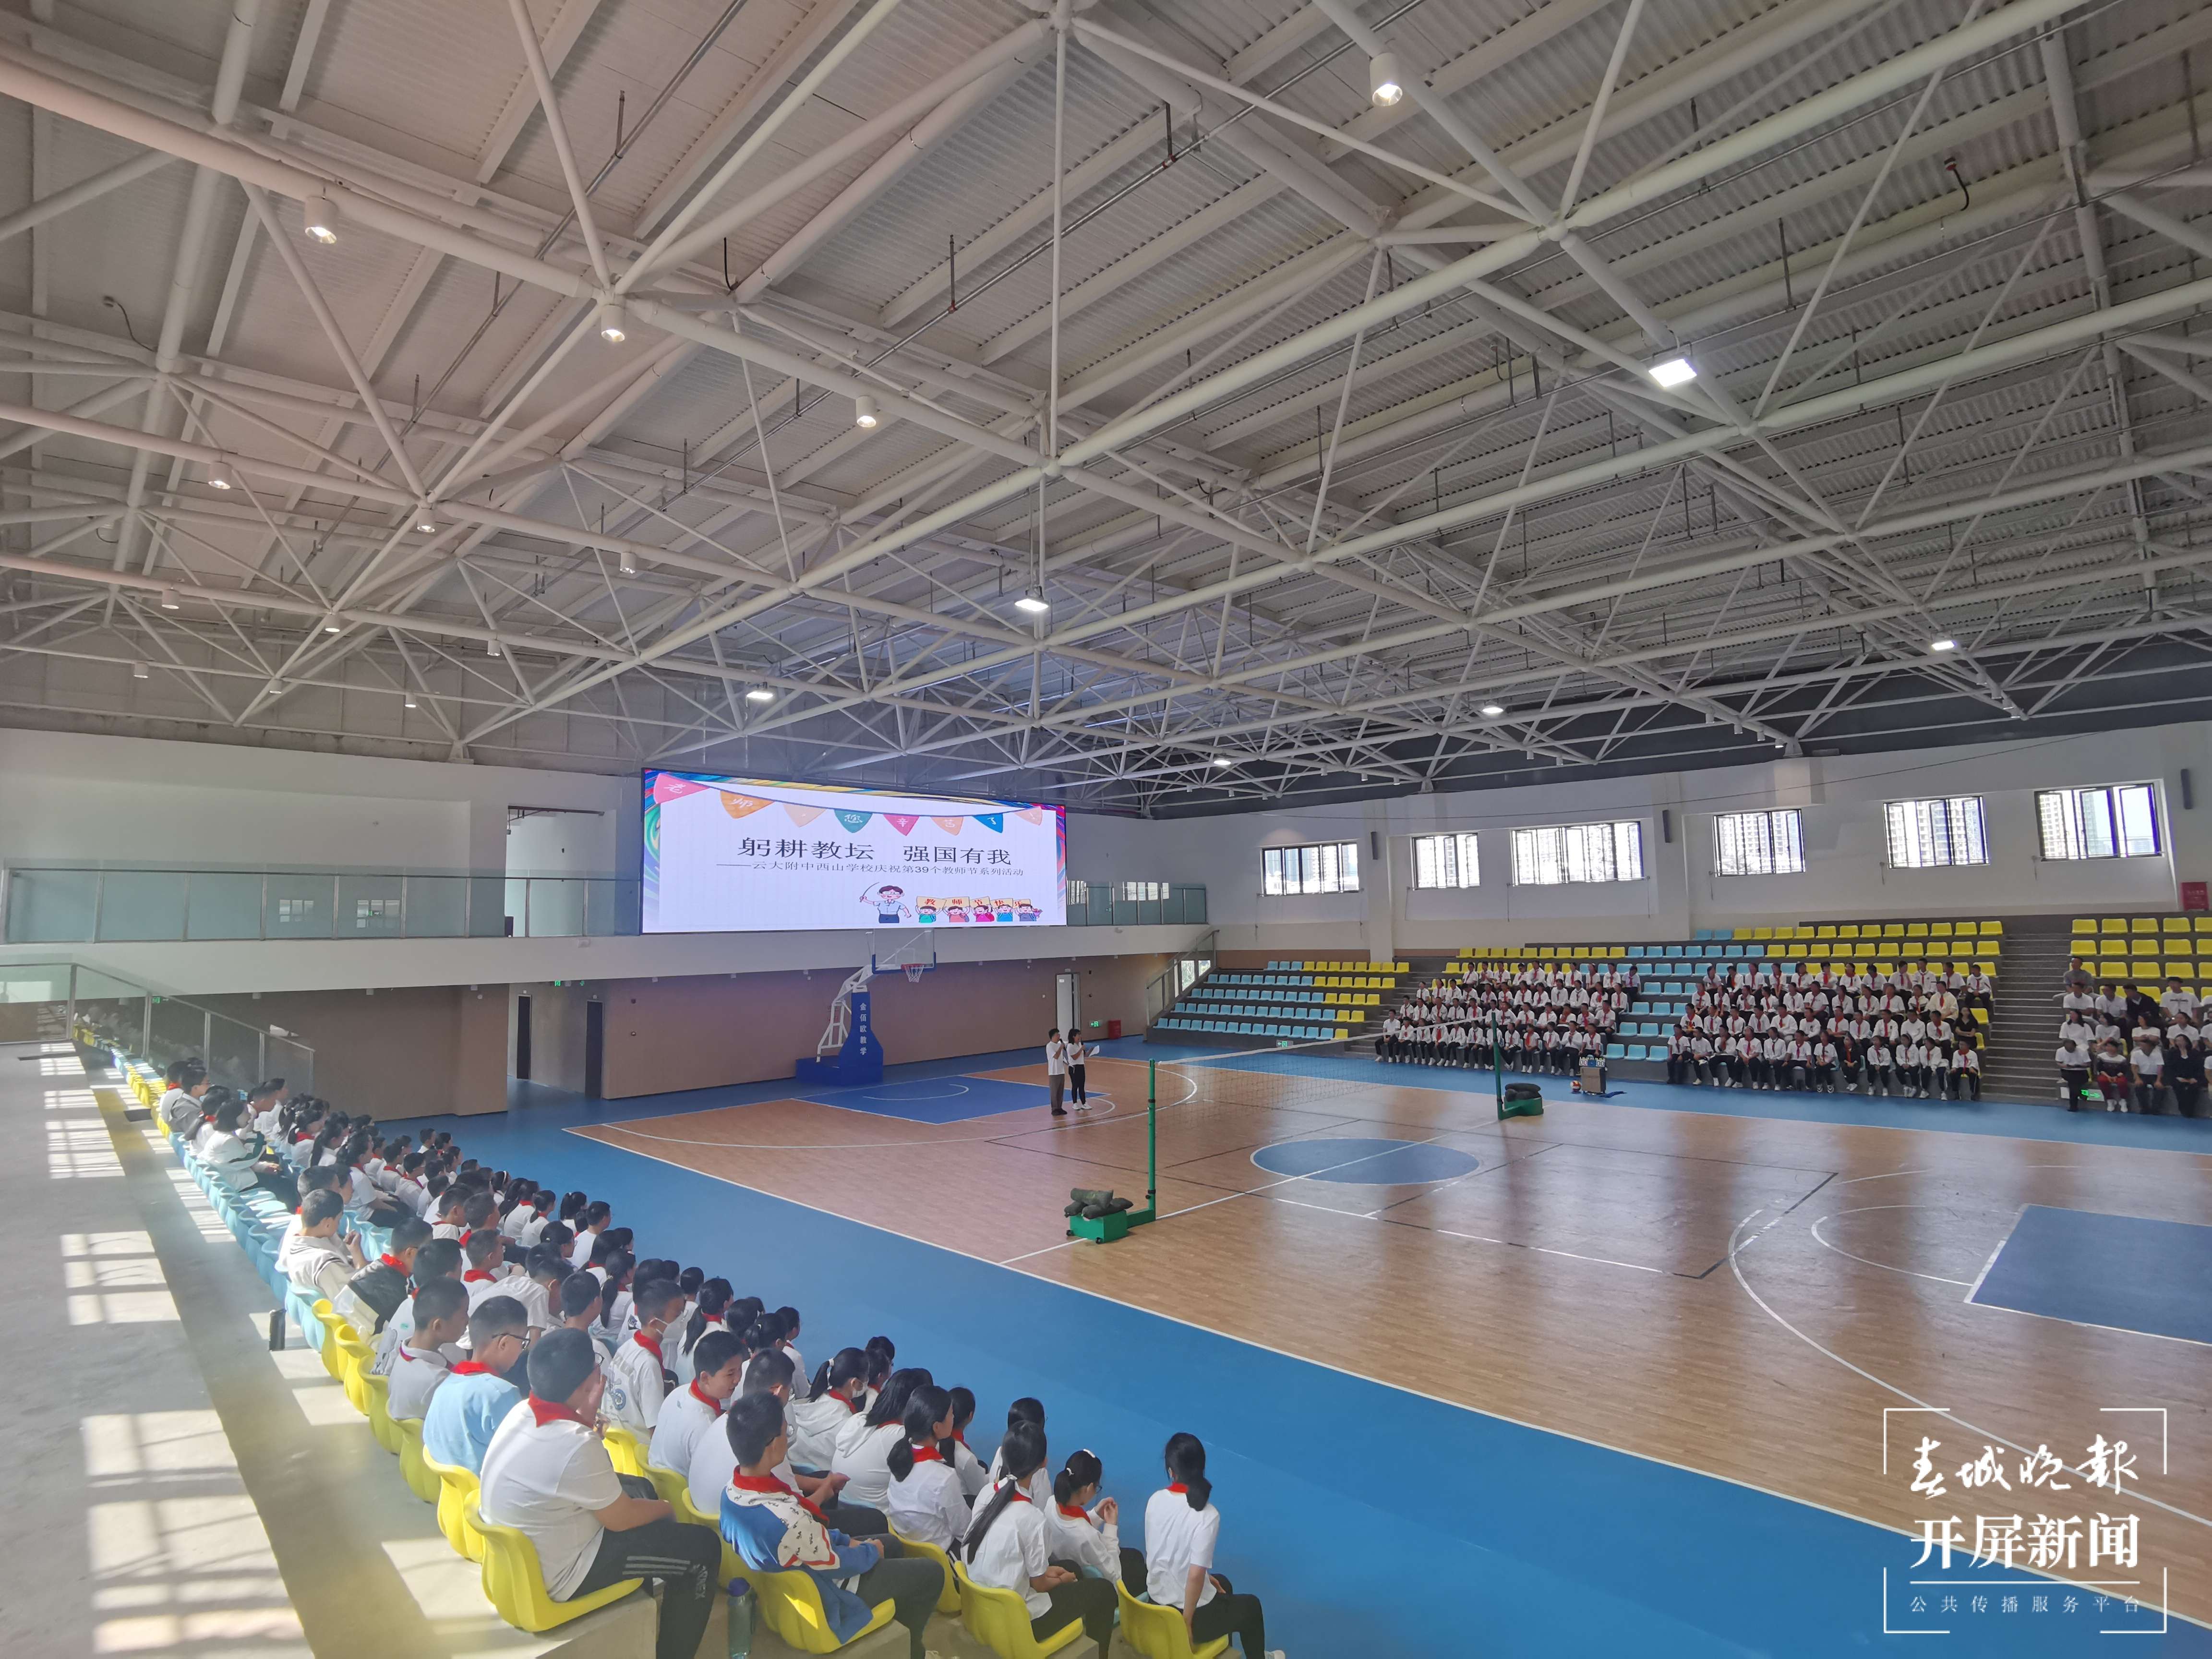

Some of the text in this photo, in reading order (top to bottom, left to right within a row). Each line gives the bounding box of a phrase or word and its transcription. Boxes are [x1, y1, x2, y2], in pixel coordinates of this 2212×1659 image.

[737, 837, 1011, 865] 躬耕教坛 强国有我
